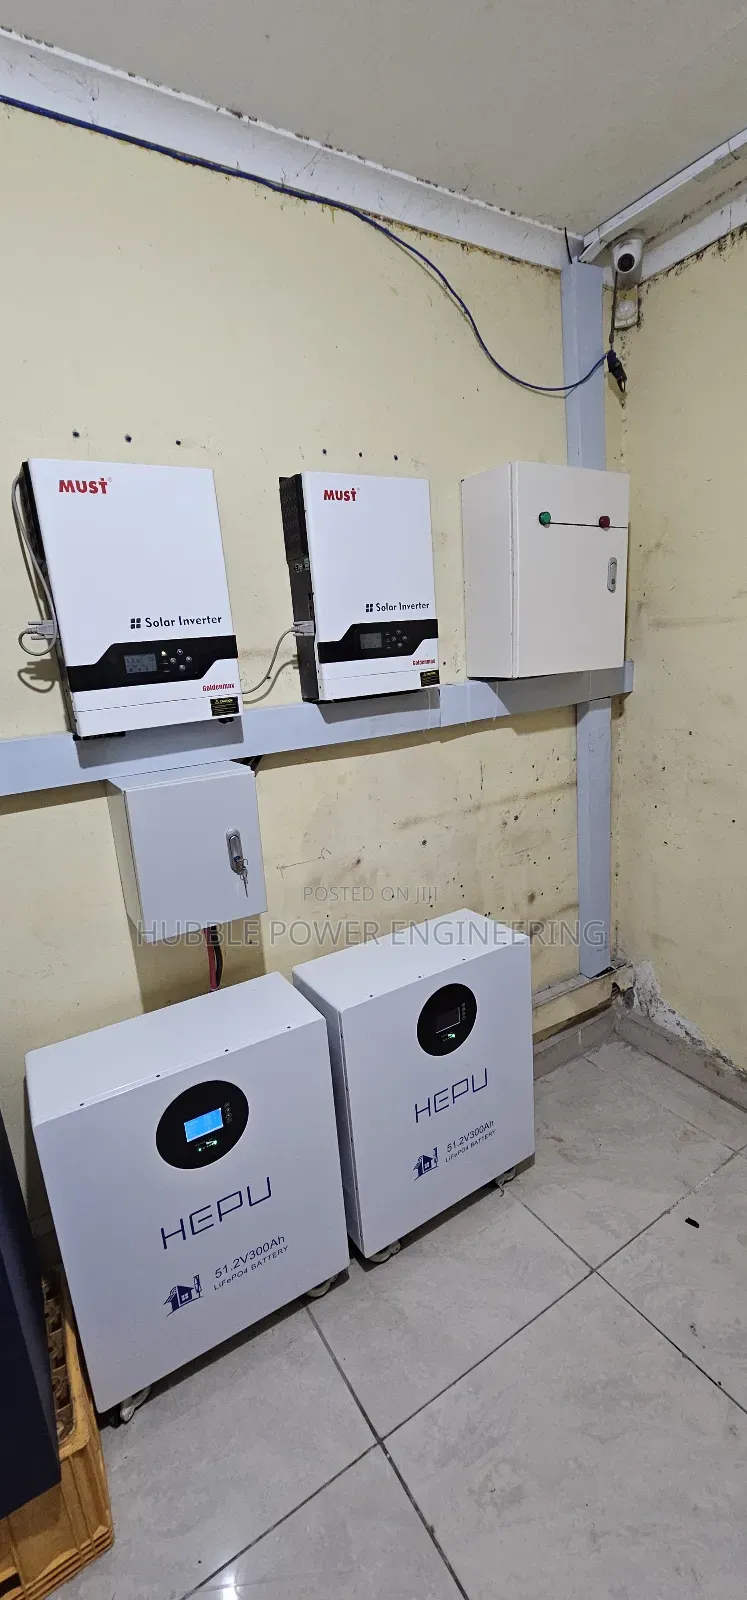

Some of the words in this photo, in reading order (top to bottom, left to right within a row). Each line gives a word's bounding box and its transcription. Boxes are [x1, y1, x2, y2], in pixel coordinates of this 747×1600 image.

[58, 477, 108, 494] MUST
[323, 487, 357, 502] MUST
[375, 602, 398, 612] Solar
[398, 602, 430, 611] Inverter
[145, 617, 176, 628] Solar
[178, 615, 222, 627] Inverter
[414, 1067, 489, 1124] HEPU
[446, 1120, 495, 1153] 51.2V300Ah
[470, 1129, 497, 1148] BATTERY
[160, 1176, 272, 1250] HEPU
[213, 1267, 249, 1291] LiFePO4
[250, 1244, 290, 1272] BATTERY
[214, 1234, 286, 1279] 51.2V300Ah
